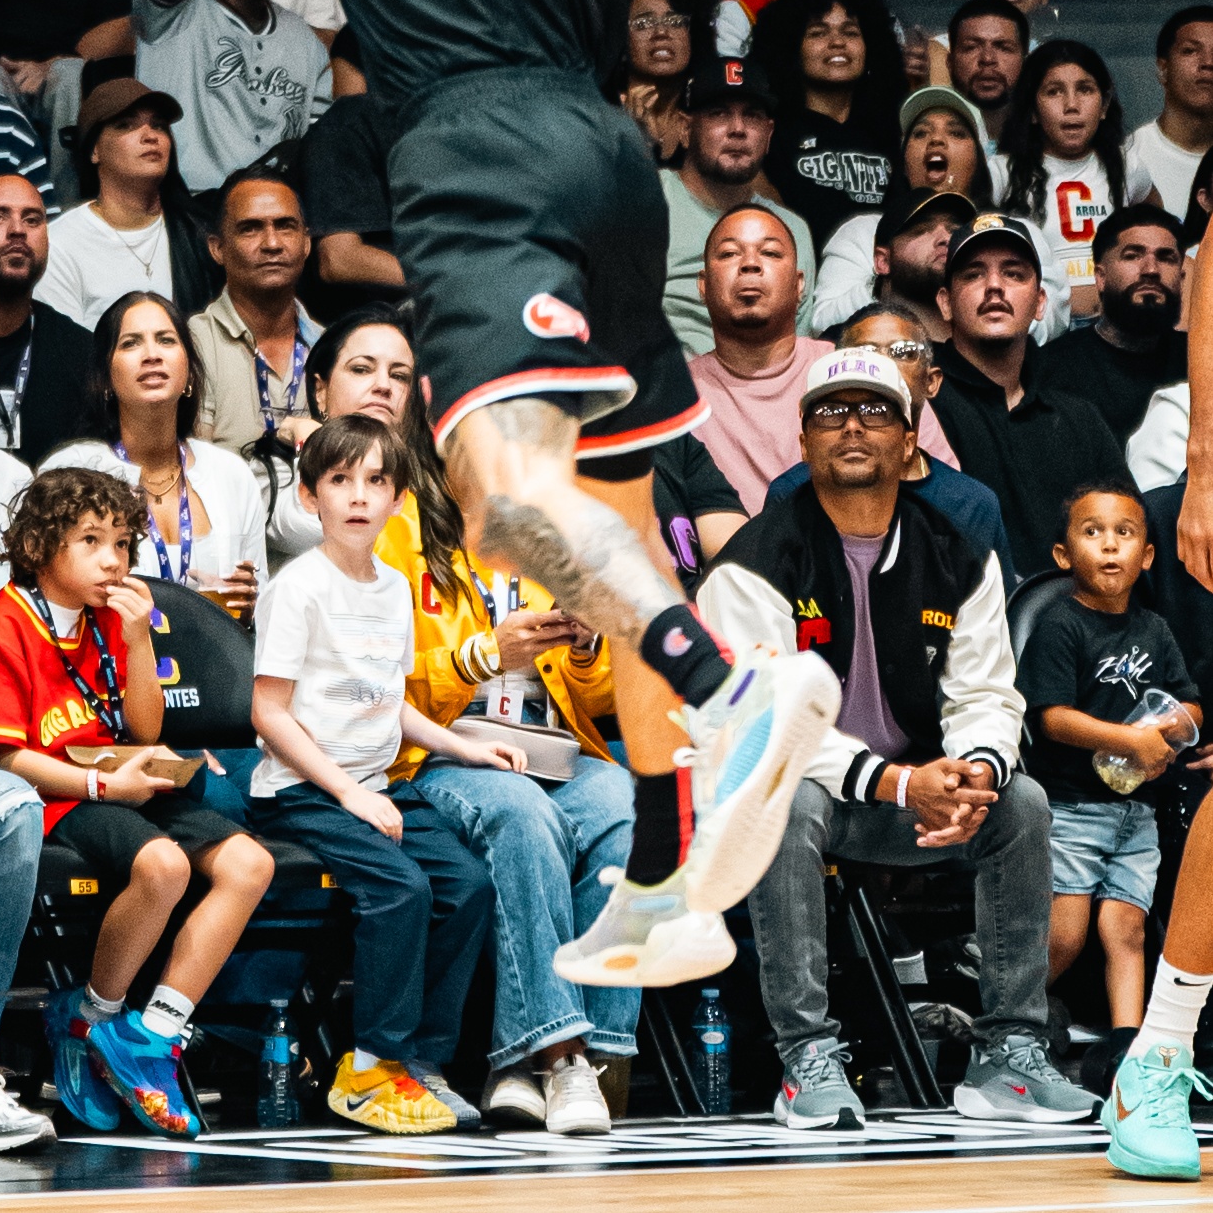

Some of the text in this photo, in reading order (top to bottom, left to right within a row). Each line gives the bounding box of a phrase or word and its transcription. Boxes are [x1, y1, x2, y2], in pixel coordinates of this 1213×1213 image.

[725, 61, 744, 86] C
[163, 687, 200, 709] NTES
[78, 881, 92, 893] 55
